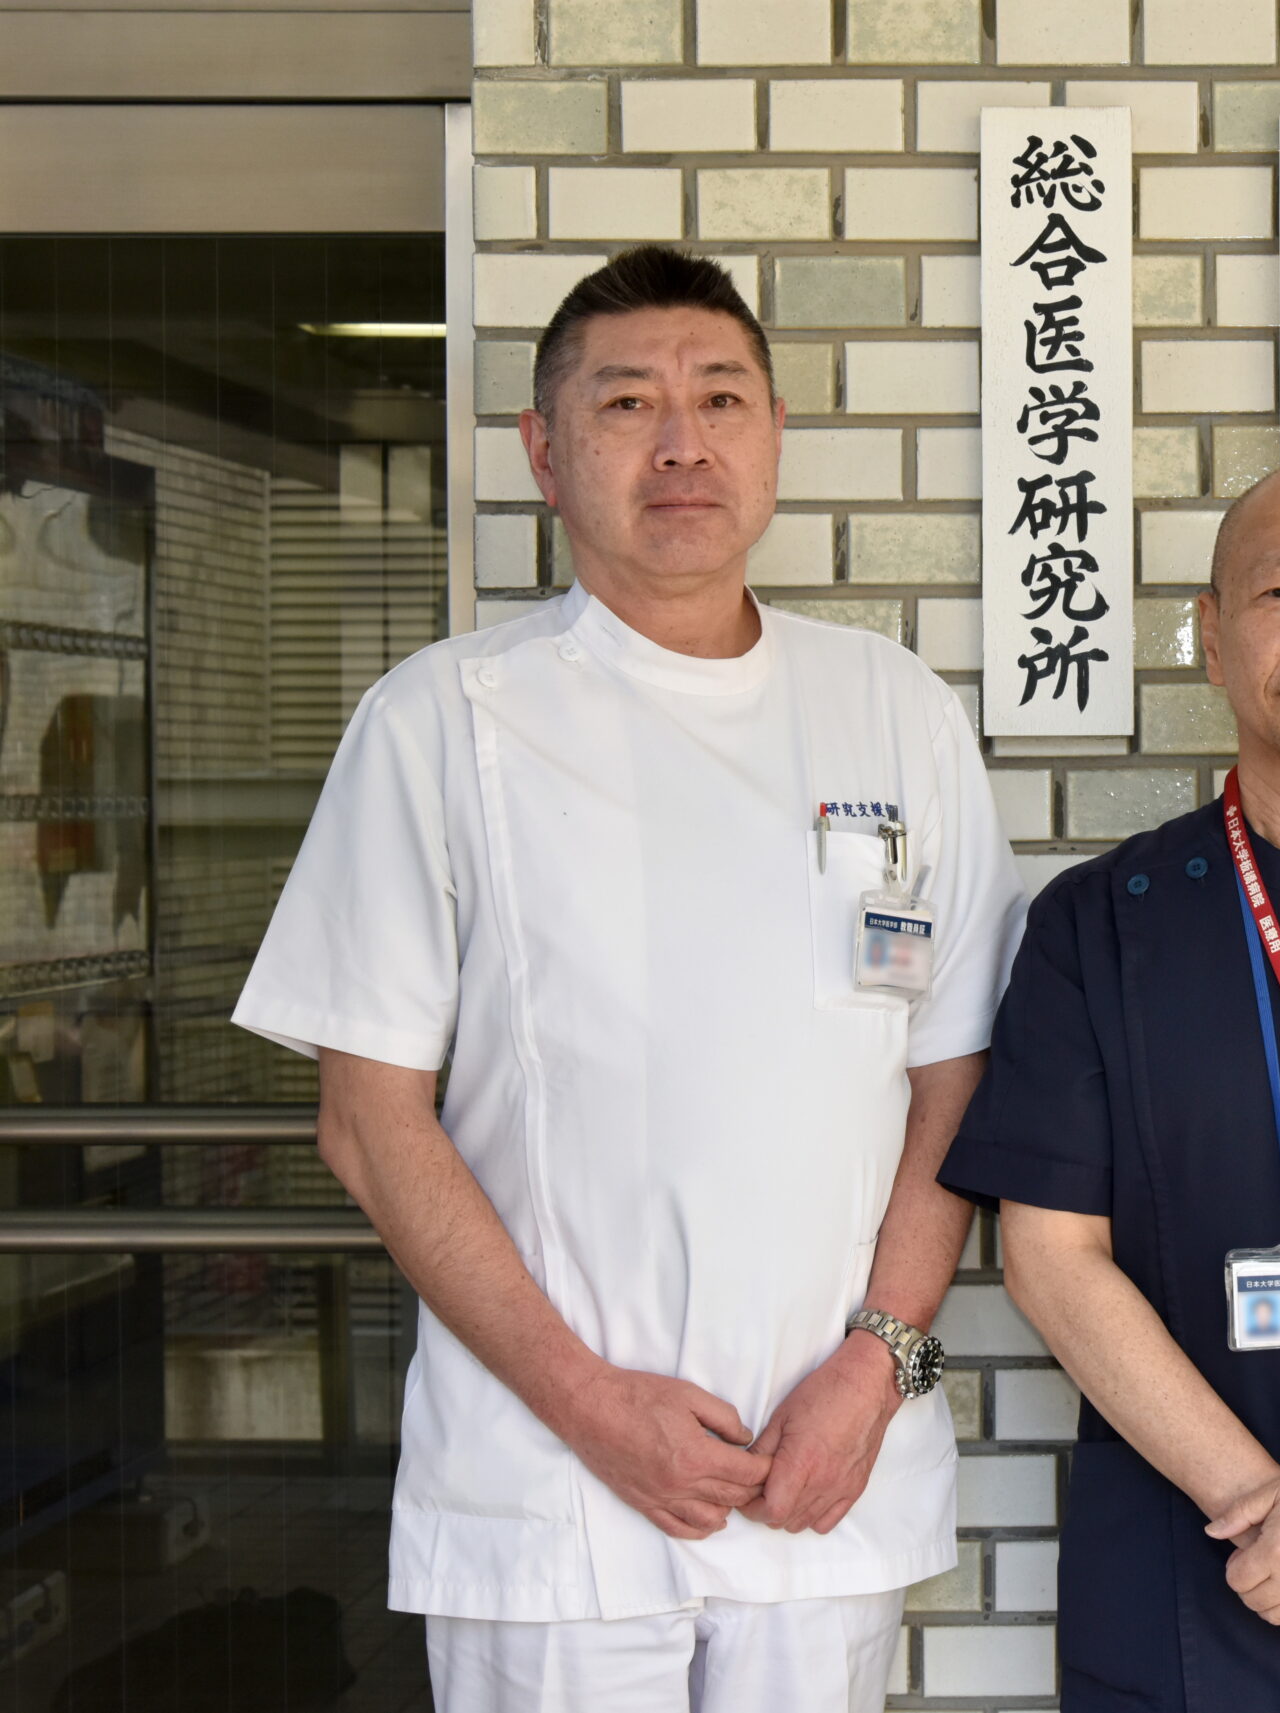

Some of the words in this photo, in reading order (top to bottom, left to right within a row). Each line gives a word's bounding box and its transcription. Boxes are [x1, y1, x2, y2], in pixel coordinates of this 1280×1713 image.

[1008, 134, 1110, 713] 総合医学研究所
